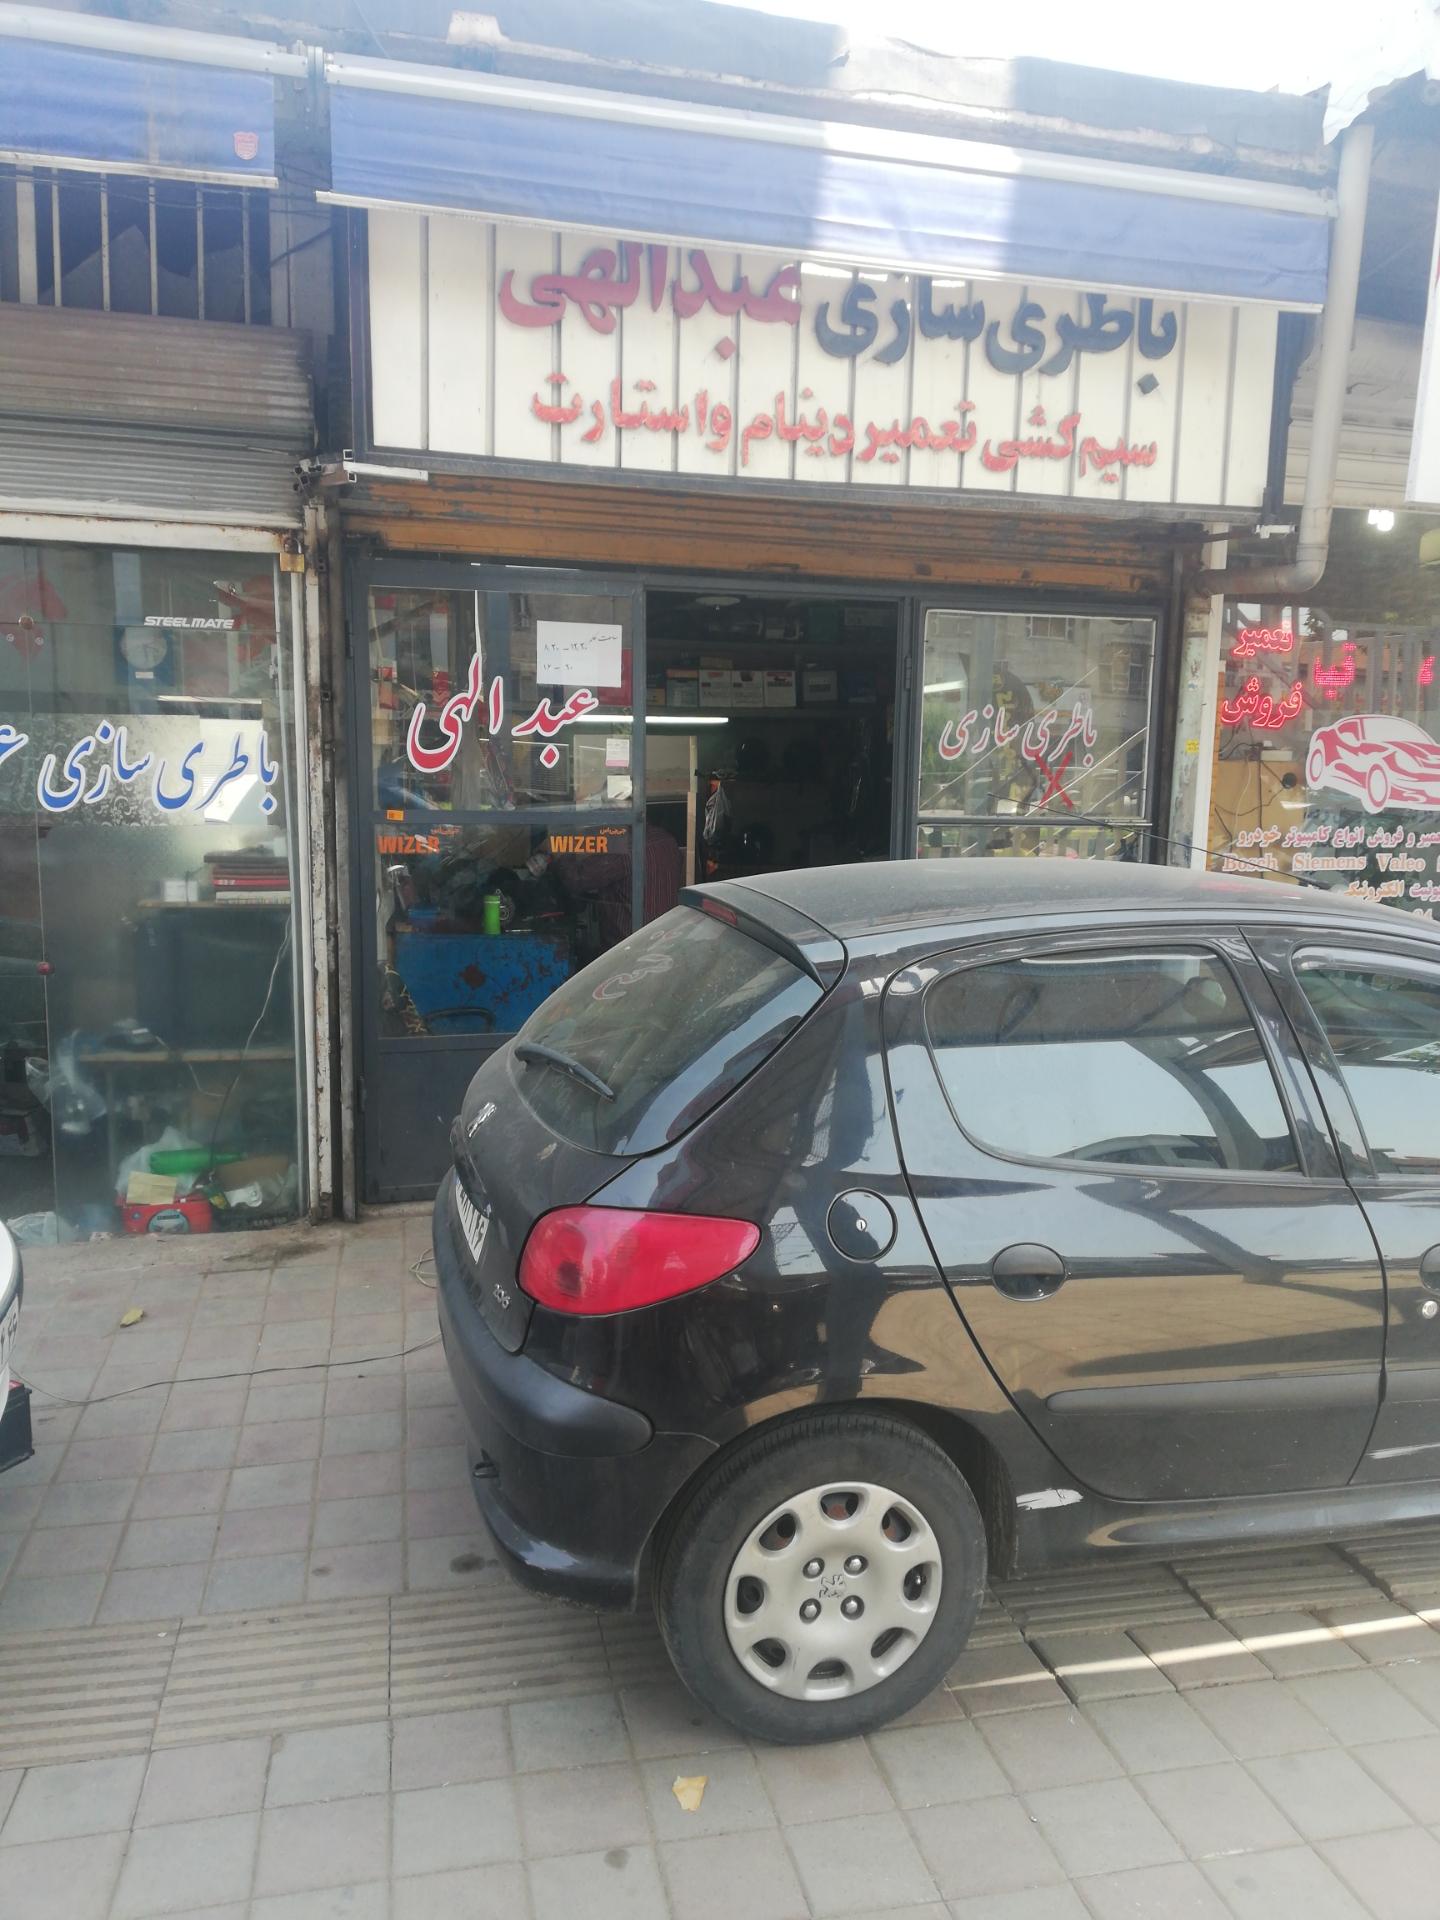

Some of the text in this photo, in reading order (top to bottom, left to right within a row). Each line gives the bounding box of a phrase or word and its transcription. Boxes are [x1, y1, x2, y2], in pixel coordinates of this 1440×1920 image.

[815, 273, 986, 365] سازی
[984, 292, 1178, 396] باطری
[741, 387, 856, 468] دینام
[856, 399, 978, 464] تعمیر
[981, 402, 1082, 473] کشی
[1079, 433, 1158, 484] سیم
[144, 616, 235, 629] STEELMATE
[1220, 677, 1303, 729] فروش
[939, 702, 1098, 767] باطری سازی
[37, 719, 153, 813] سازی
[151, 729, 279, 815] باطری
[550, 835, 608, 853] WIZER
[1222, 853, 1280, 872] Bosch
[1292, 853, 1367, 871] Siemens
[1375, 853, 1426, 872] Valeo
[1236, 825, 1282, 848] خودرو
[1332, 826, 1365, 848] انواع
[1366, 825, 1404, 848] فروش
[1405, 831, 1416, 848] و
